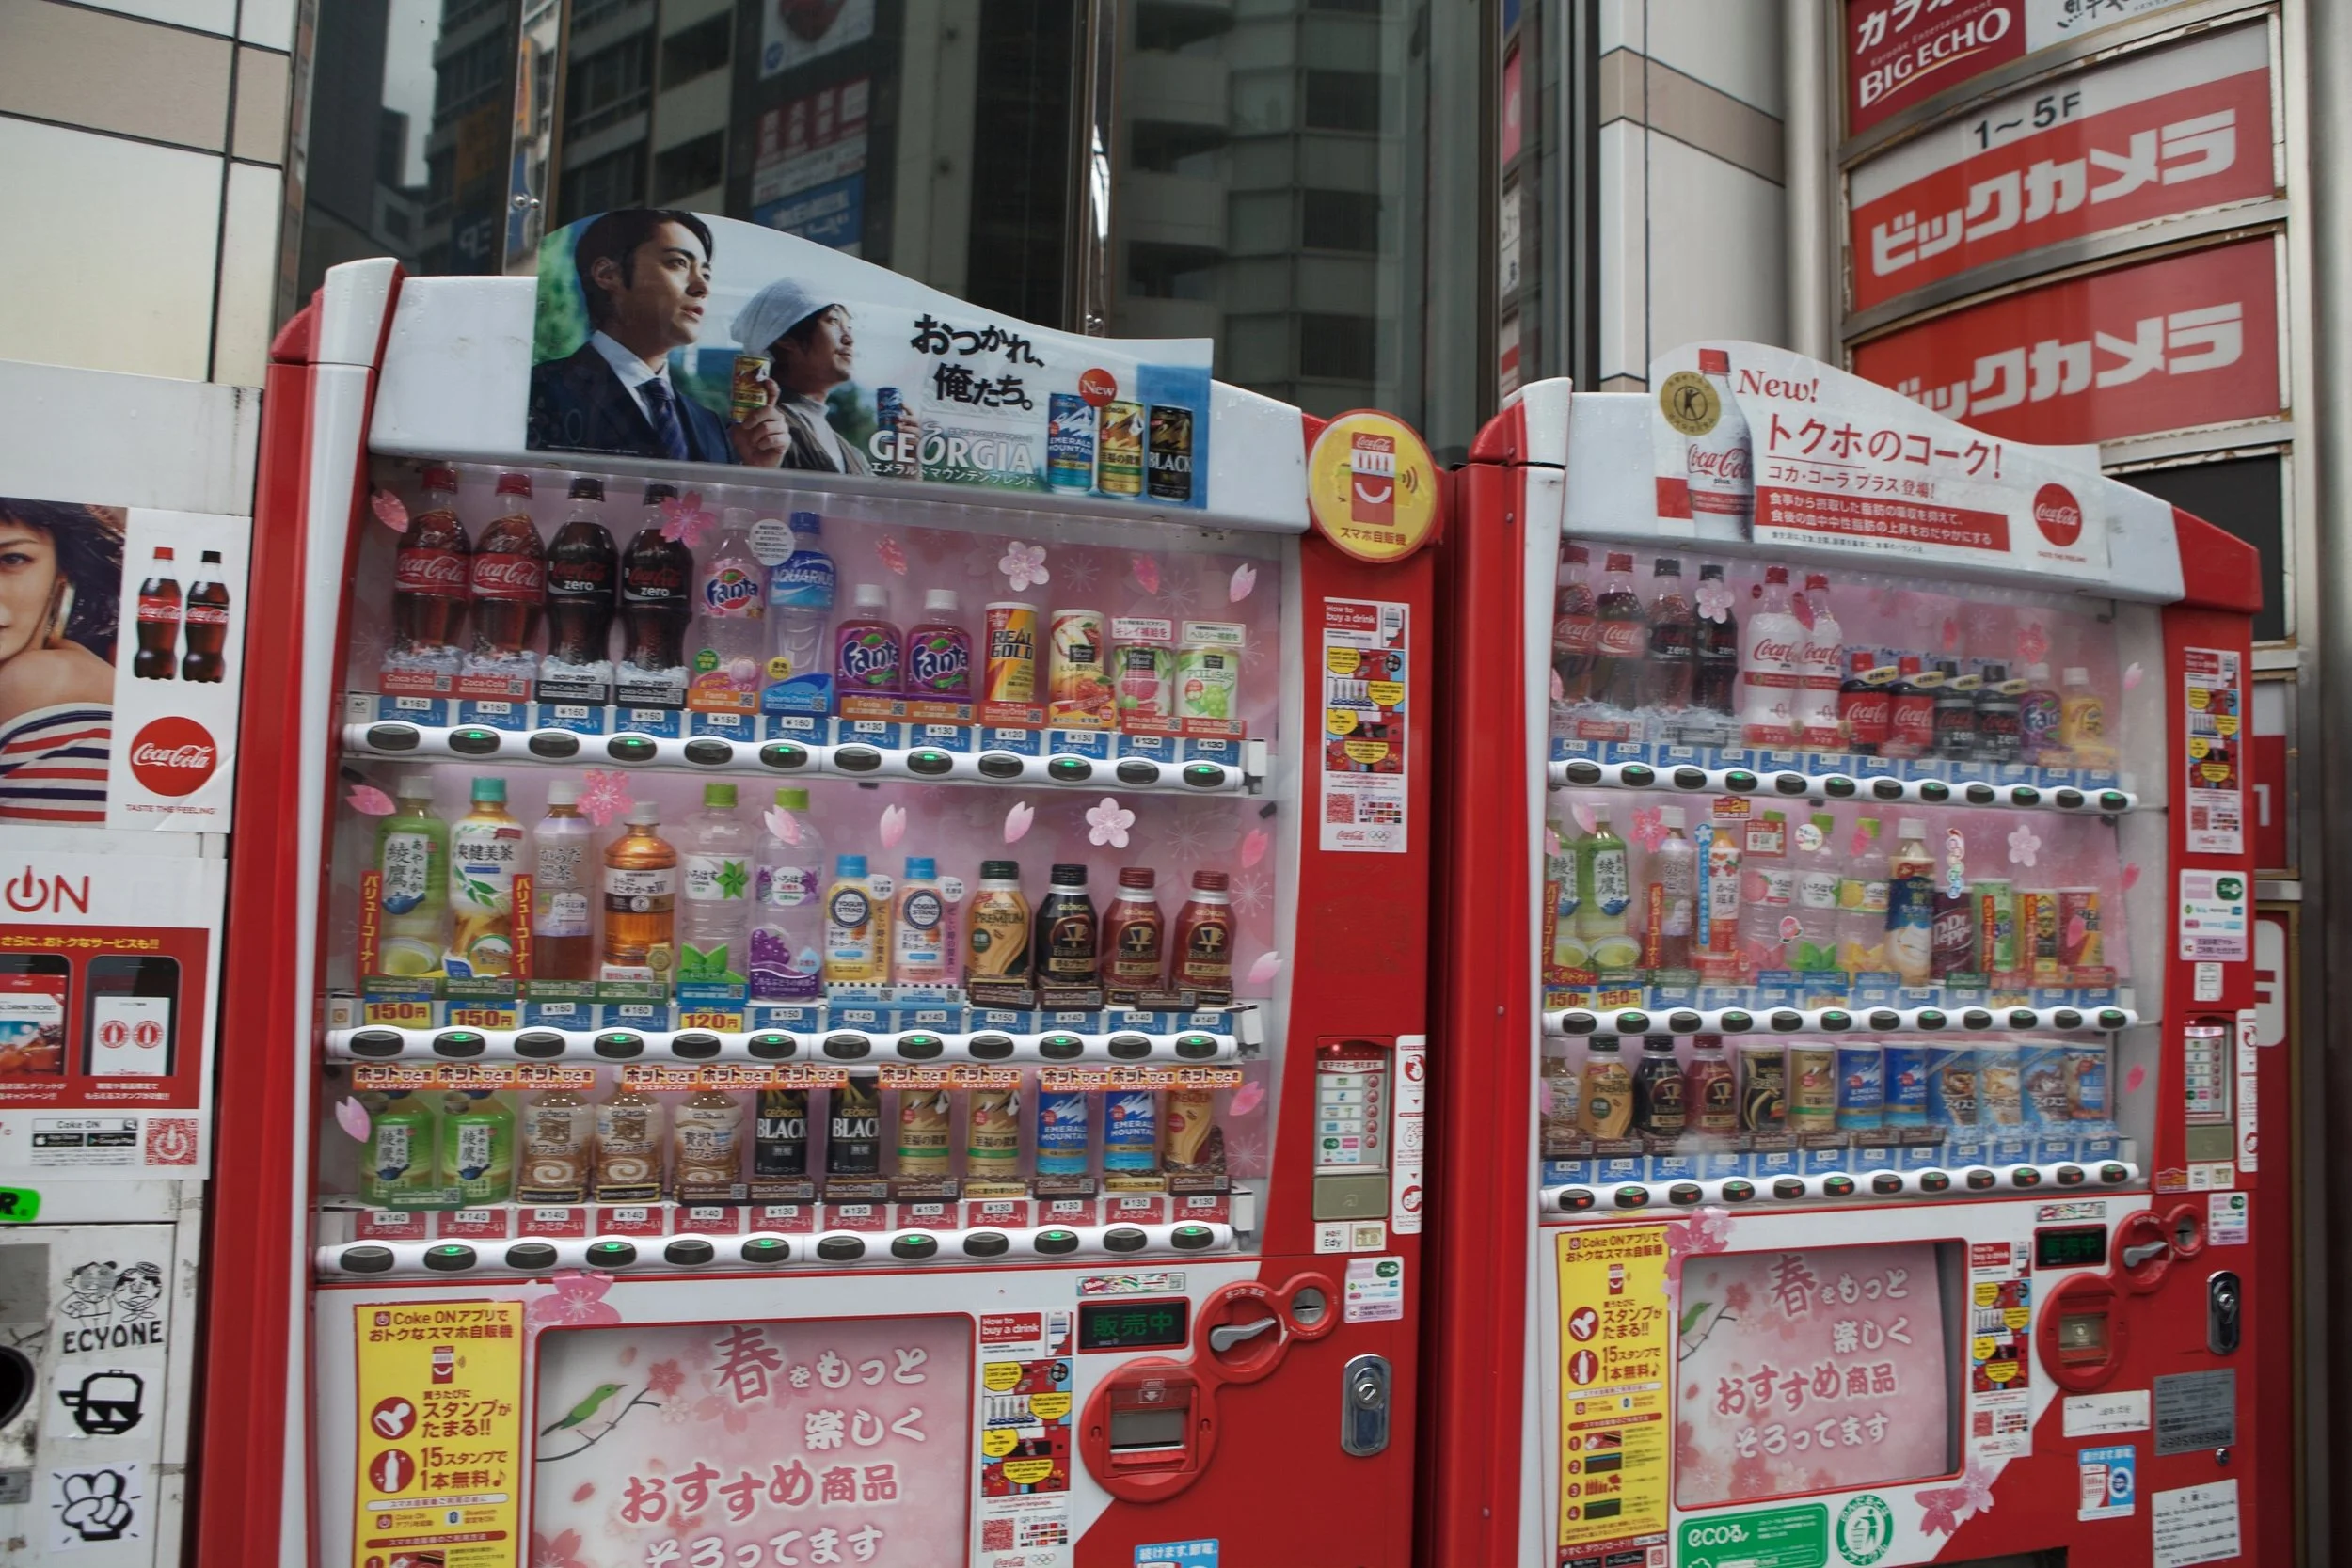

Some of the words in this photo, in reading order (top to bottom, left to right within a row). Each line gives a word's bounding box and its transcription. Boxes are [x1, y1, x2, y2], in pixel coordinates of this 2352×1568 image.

[1860, 55, 1912, 108] BIG
[1917, 8, 2011, 67] ECHO
[1871, 109, 2236, 277] ビックカメラ
[910, 314, 1044, 367] おつかれ、
[933, 363, 1033, 410] 俺たち。
[1083, 379, 1115, 397] New
[1738, 369, 1820, 404] New!
[868, 423, 1034, 474] GEORGIA
[1357, 436, 1391, 451] Coca-Cola
[1767, 412, 2003, 479] トクホのコーク!
[1149, 453, 1192, 472] BLACK
[2036, 503, 2079, 526] Coca-Cola
[1341, 528, 1407, 546] スマホ自販機
[473, 557, 543, 589] Coca-Cola
[564, 579, 594, 591] zero
[641, 586, 670, 597] zero
[707, 577, 758, 607] Fanta
[843, 640, 899, 676] Fanta
[912, 643, 968, 681] Fanta
[991, 644, 1034, 659] GOLD
[132, 742, 215, 768] Coca-Cola
[386, 842, 412, 887] 綾鷹
[411, 838, 424, 893] あやたか
[361, 876, 379, 974] バリューコーナー
[515, 879, 532, 974] バリューコーナー
[368, 1003, 427, 1020] 150円
[455, 1010, 513, 1028] 150円
[685, 1014, 739, 1029] 120円
[1565, 1244, 1663, 1262] おトクなスマホ自販機
[1582, 1236, 1607, 1249] Coke
[1771, 1254, 1909, 1317] 春をもっと
[394, 1311, 431, 1325] Coke
[982, 1325, 1003, 1336] buy
[1012, 1323, 1040, 1334] drink
[1092, 1311, 1174, 1338] 販売中
[1602, 1306, 1661, 1324] スタンプが
[63, 1320, 164, 1354] ECYONE
[369, 1324, 513, 1342] おトクなスマホ自販機
[1834, 1318, 1912, 1354] 楽しく
[714, 1325, 928, 1404] 春をもっと
[1602, 1345, 1660, 1363] 15スタンプで
[423, 1389, 471, 1400] 買うたびに
[1716, 1361, 1897, 1415] おすすめ商品
[422, 1399, 512, 1419] スタンプが
[804, 1408, 926, 1450] 楽しく
[1736, 1412, 1889, 1458] そろってます
[421, 1447, 508, 1468] 15スタンプで
[619, 1459, 898, 1524] おすすめ商品
[646, 1524, 883, 1568] そろってます
